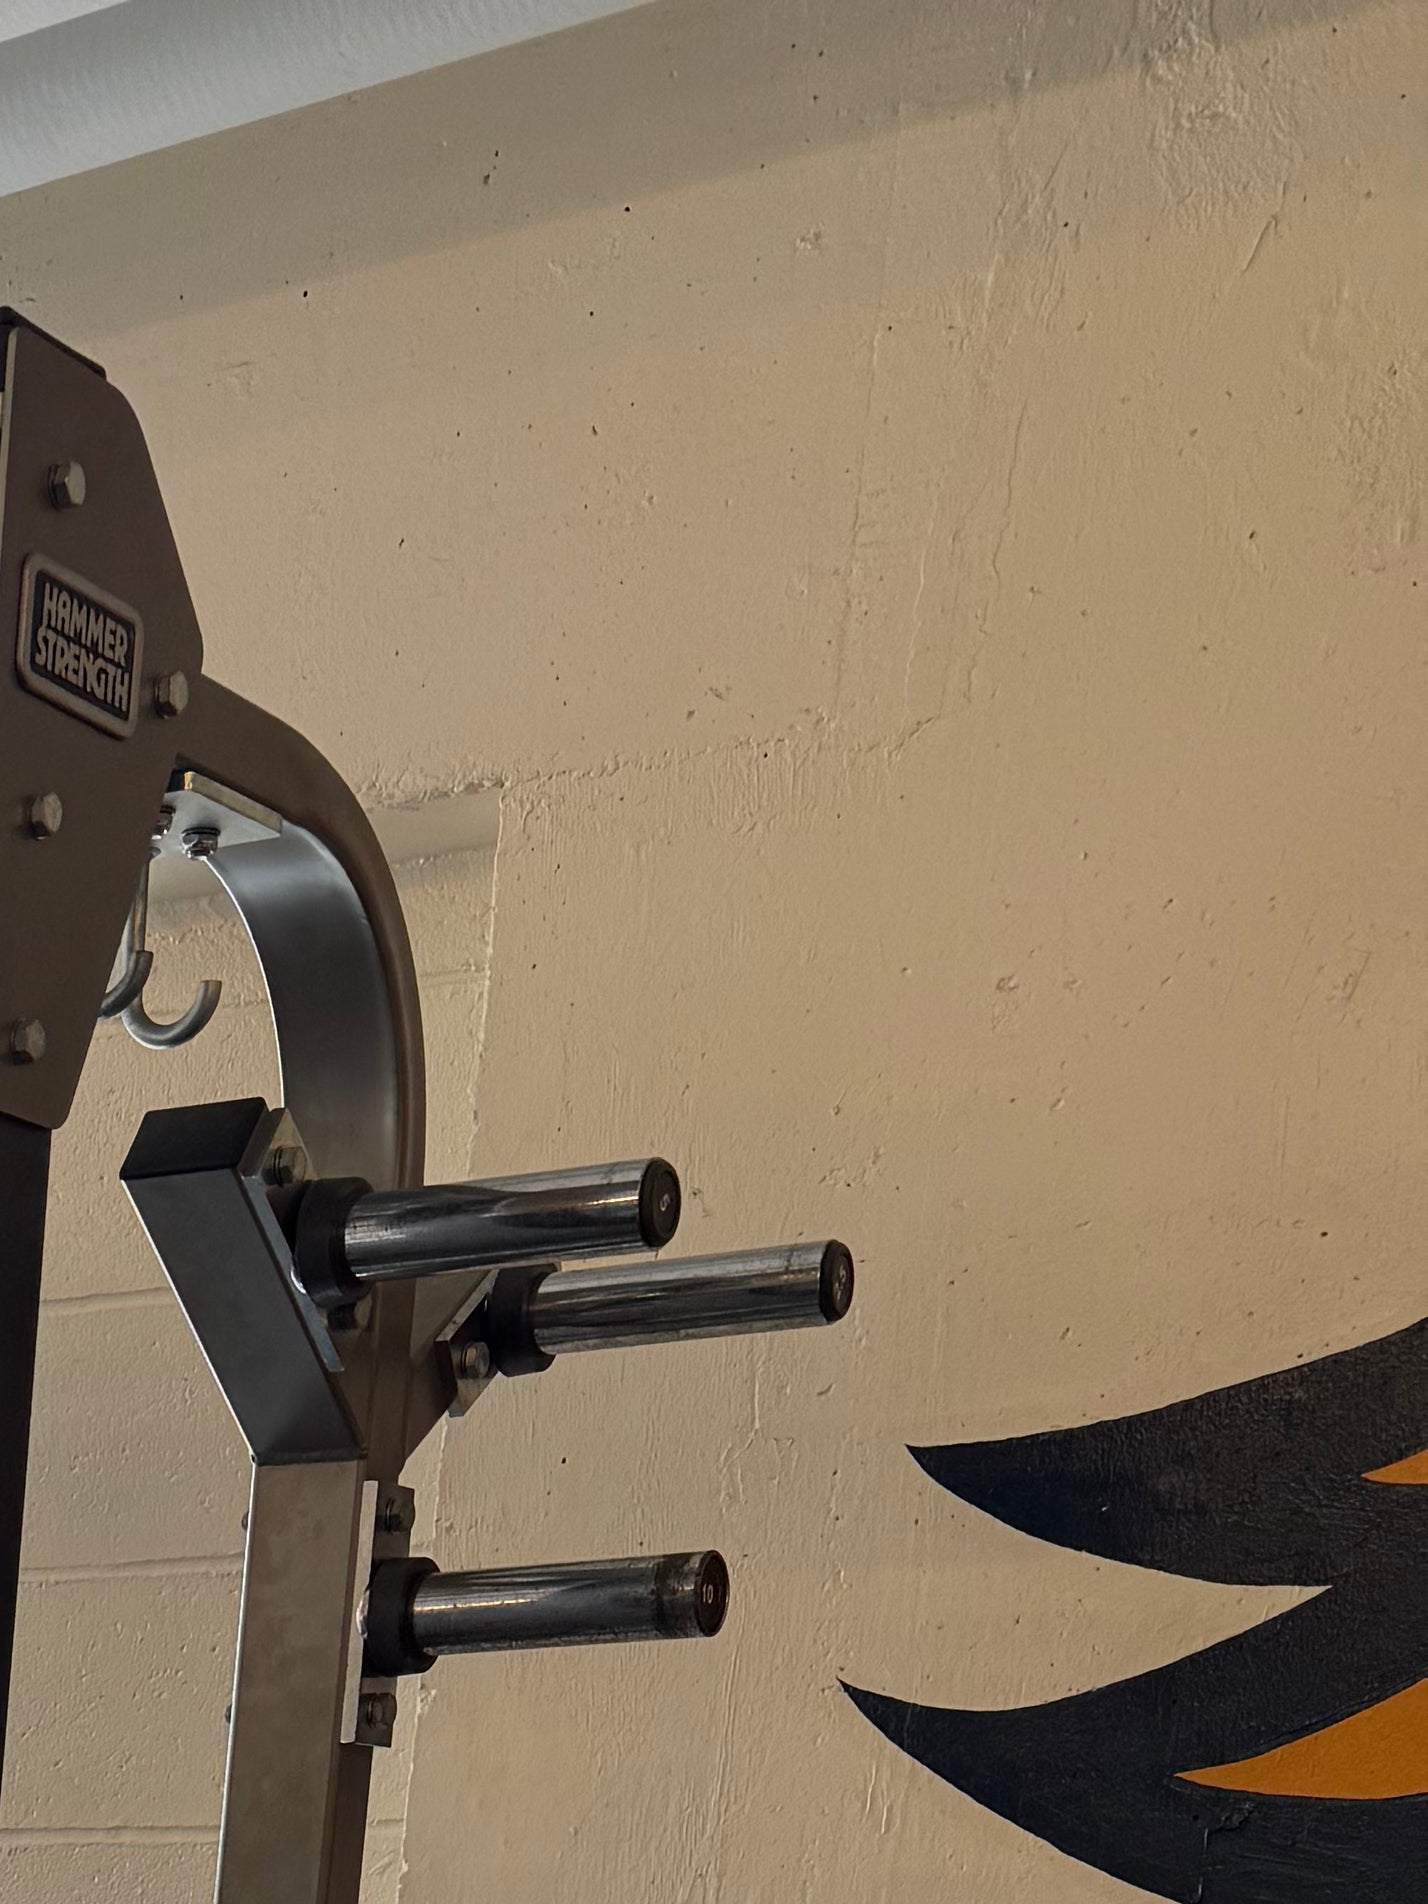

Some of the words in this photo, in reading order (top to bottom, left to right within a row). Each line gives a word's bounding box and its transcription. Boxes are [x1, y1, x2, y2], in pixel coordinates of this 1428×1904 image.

[42, 582, 128, 666] HAMMER
[34, 626, 130, 712] STRENGTH
[702, 1583, 714, 1605] 10
